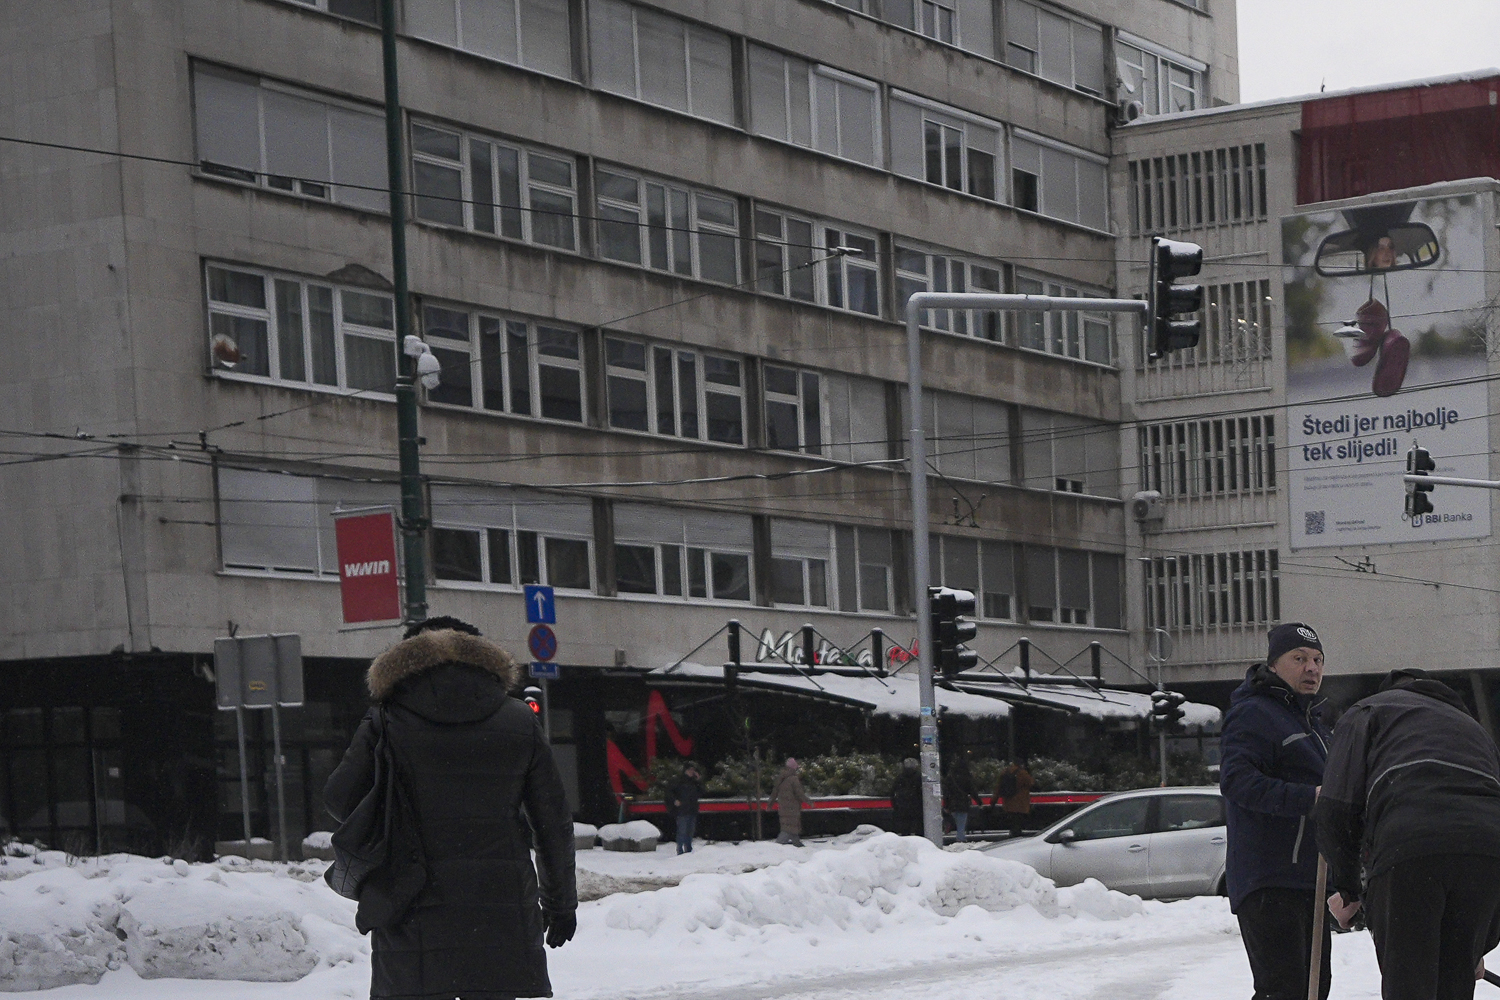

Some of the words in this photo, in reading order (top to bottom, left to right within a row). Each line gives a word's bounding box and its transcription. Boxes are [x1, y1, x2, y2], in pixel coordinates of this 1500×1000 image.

[1302, 414, 1350, 436] Štedi
[1353, 414, 1380, 437] jer
[1383, 407, 1459, 433] najbolje
[1302, 441, 1333, 461] tek
[1336, 438, 1398, 463] slijedi!
[1425, 514, 1442, 524] BBI
[1443, 512, 1473, 522] Banka
